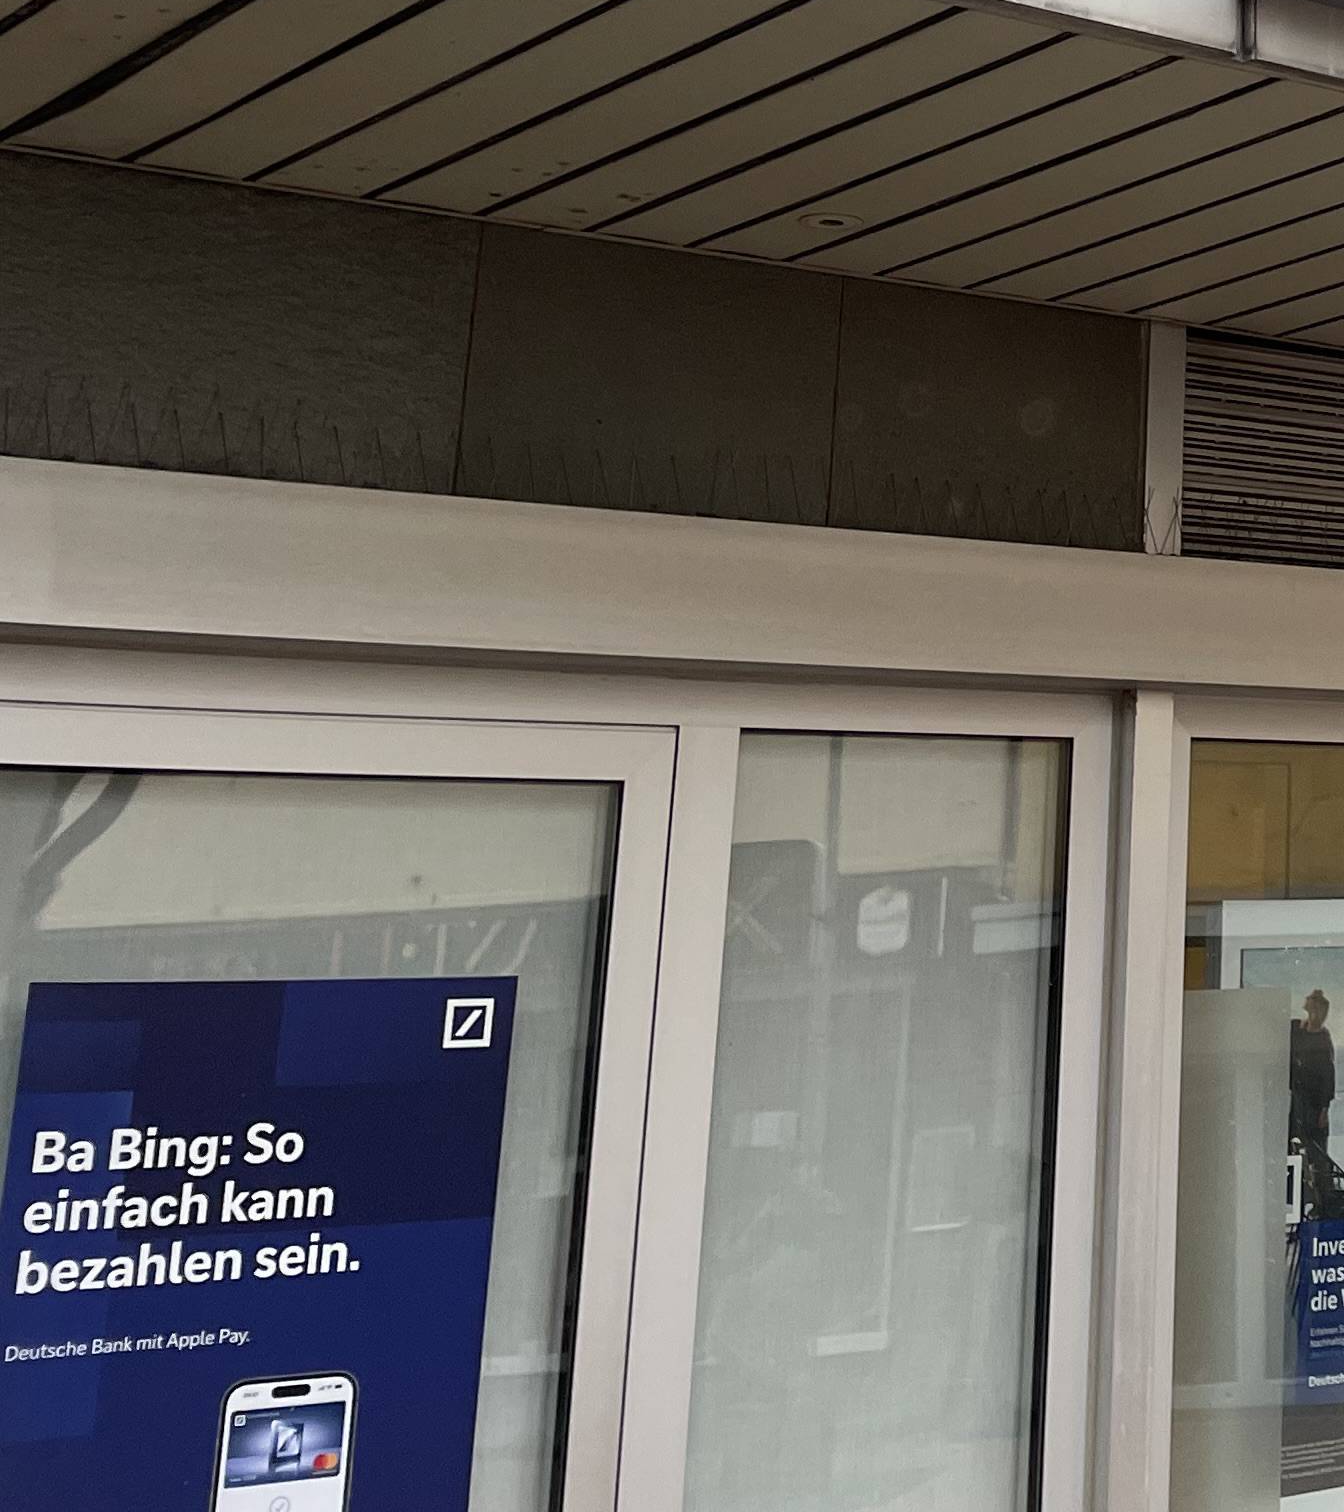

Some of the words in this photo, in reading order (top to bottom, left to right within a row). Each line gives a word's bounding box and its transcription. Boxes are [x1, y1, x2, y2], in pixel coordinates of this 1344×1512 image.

[31, 1129, 97, 1174] Ba
[108, 1126, 233, 1177] Bing:
[243, 1122, 305, 1165] So
[22, 1181, 209, 1234] einfach
[220, 1180, 335, 1223] kann
[15, 1240, 243, 1295] bezahlen
[253, 1232, 360, 1279] sein.
[1311, 1266, 1344, 1285] was
[1310, 1290, 1338, 1312] die
[4, 1340, 88, 1363] Deutsche
[91, 1336, 133, 1355] Bank
[135, 1333, 163, 1351] mit
[165, 1330, 216, 1351] Apple
[218, 1328, 251, 1346] Pay.
